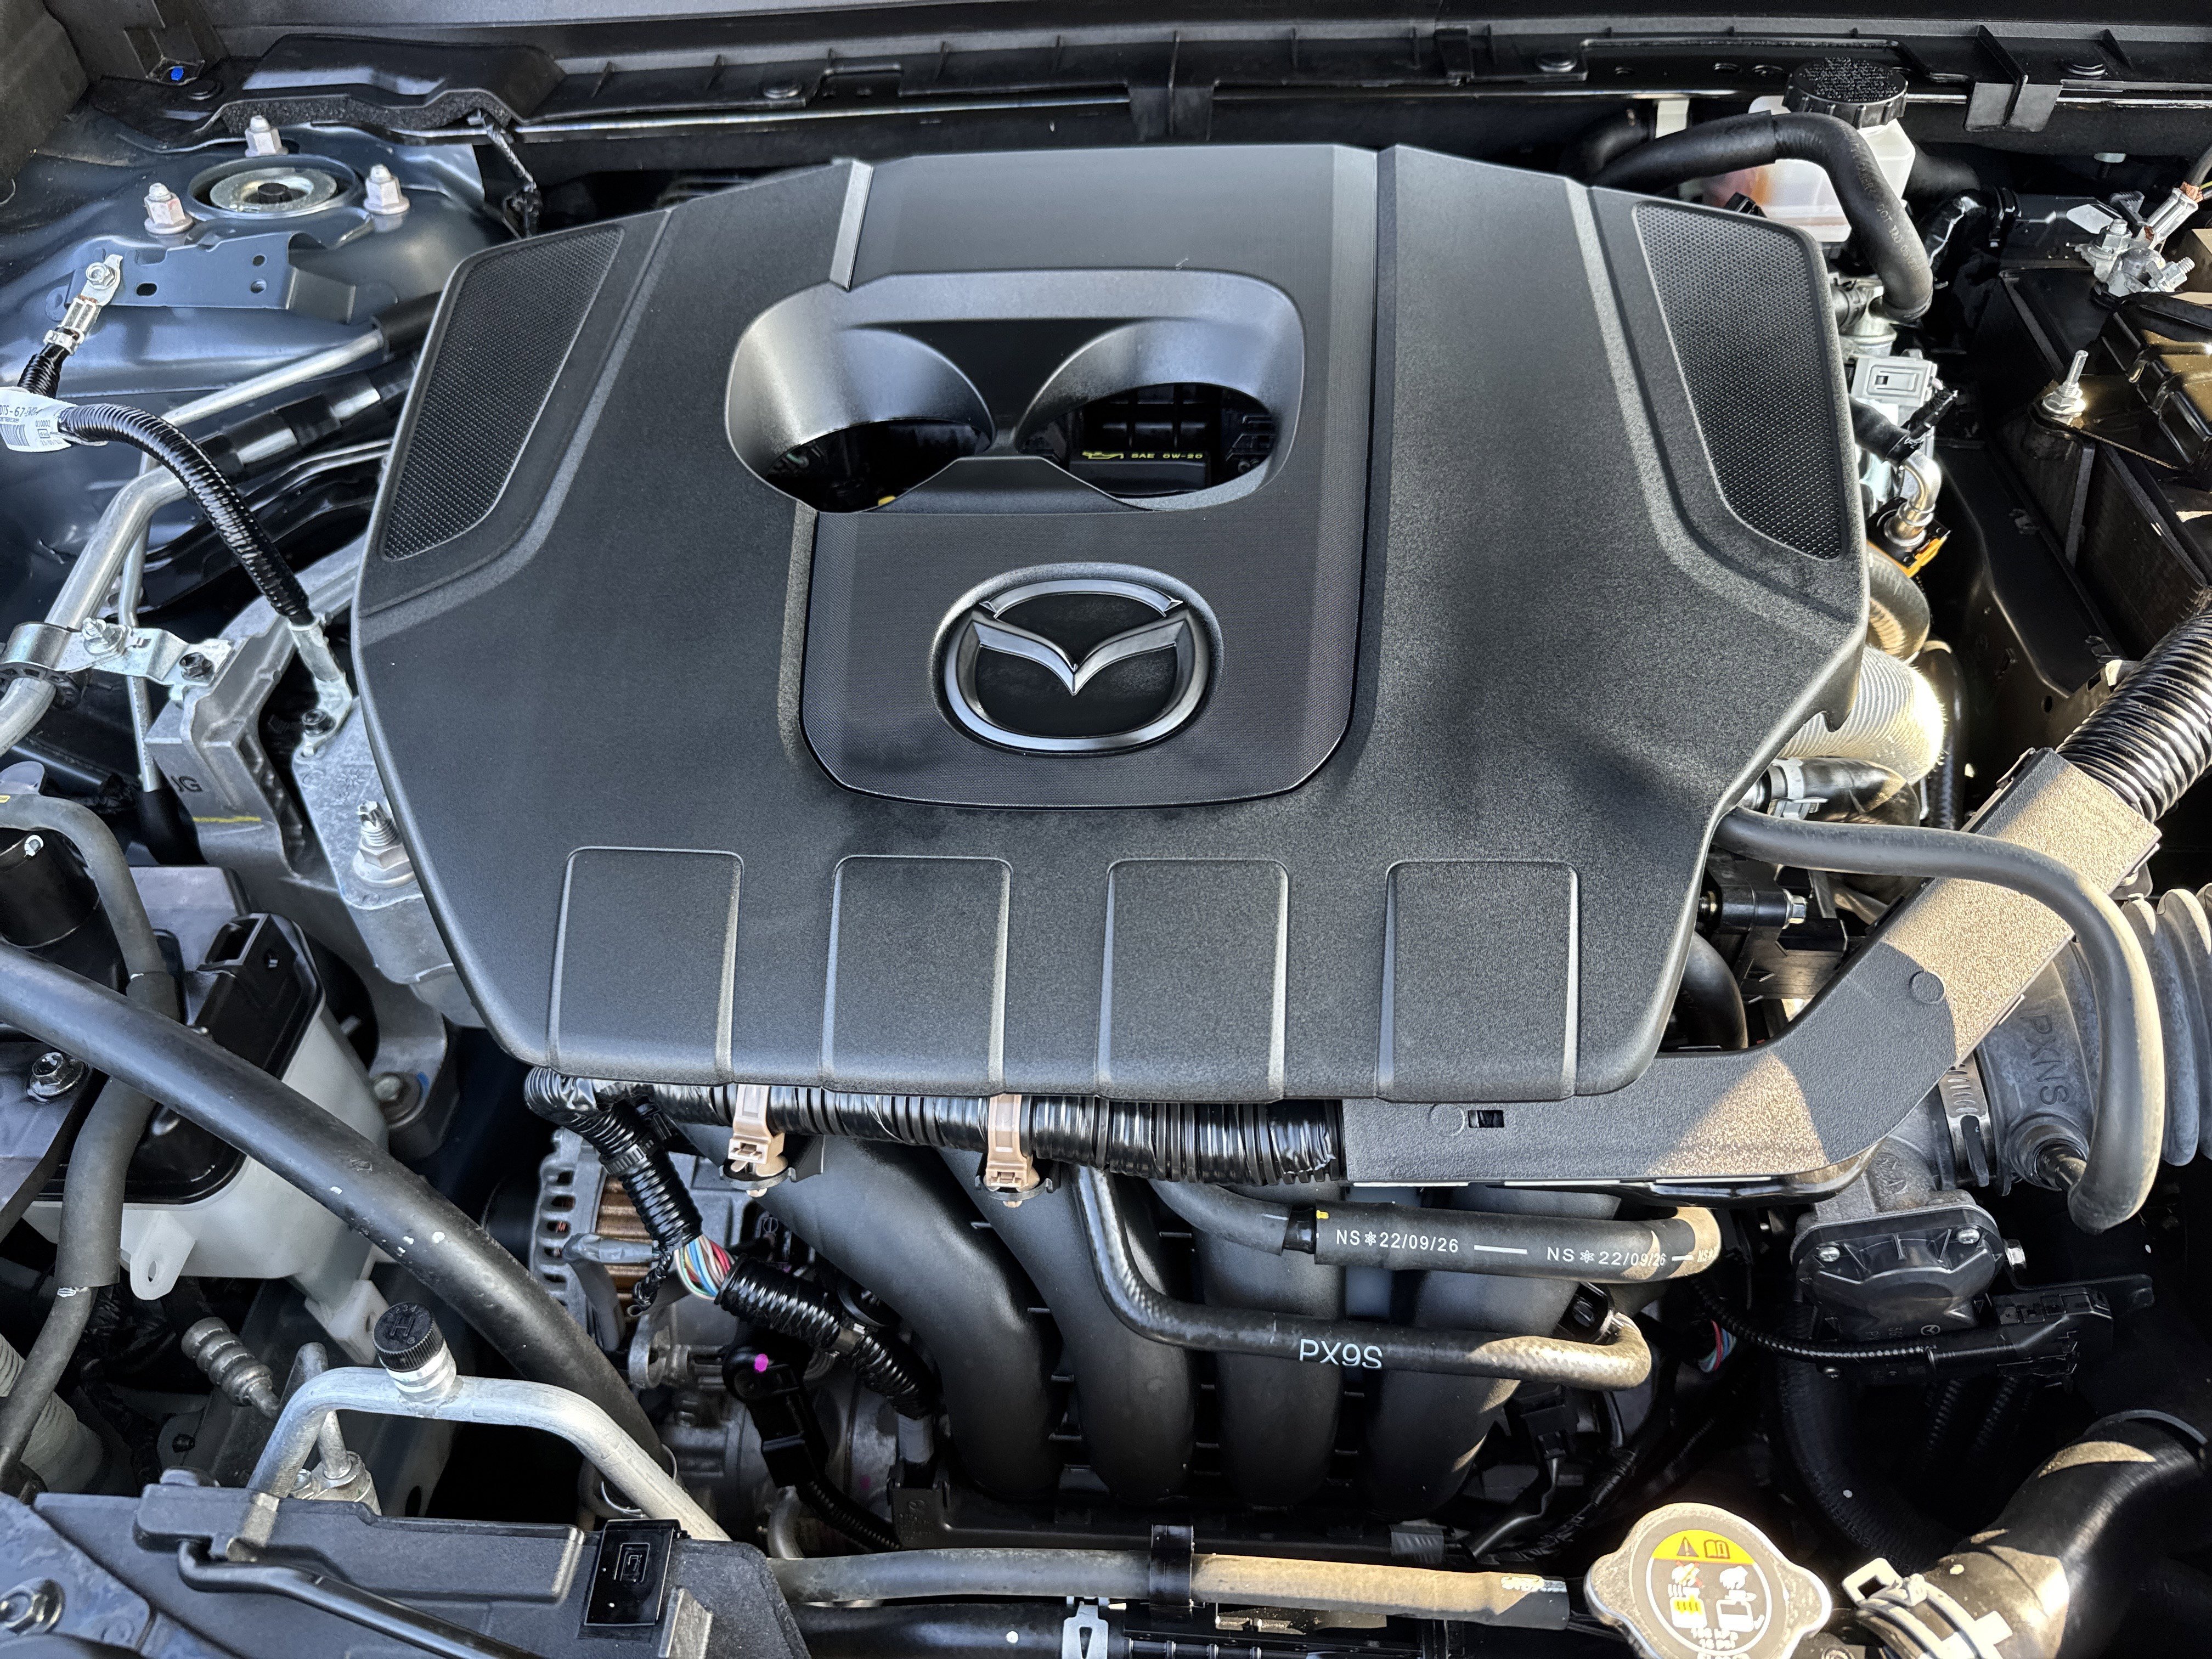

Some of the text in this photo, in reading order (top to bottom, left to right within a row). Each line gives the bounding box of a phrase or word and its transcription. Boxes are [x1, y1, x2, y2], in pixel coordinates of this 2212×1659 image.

[2019, 1014, 2069, 1105] PXNS
[1379, 1232, 1459, 1253] 22/09/26
[390, 1314, 416, 1336] H
[1299, 1339, 1383, 1369] PX9S
